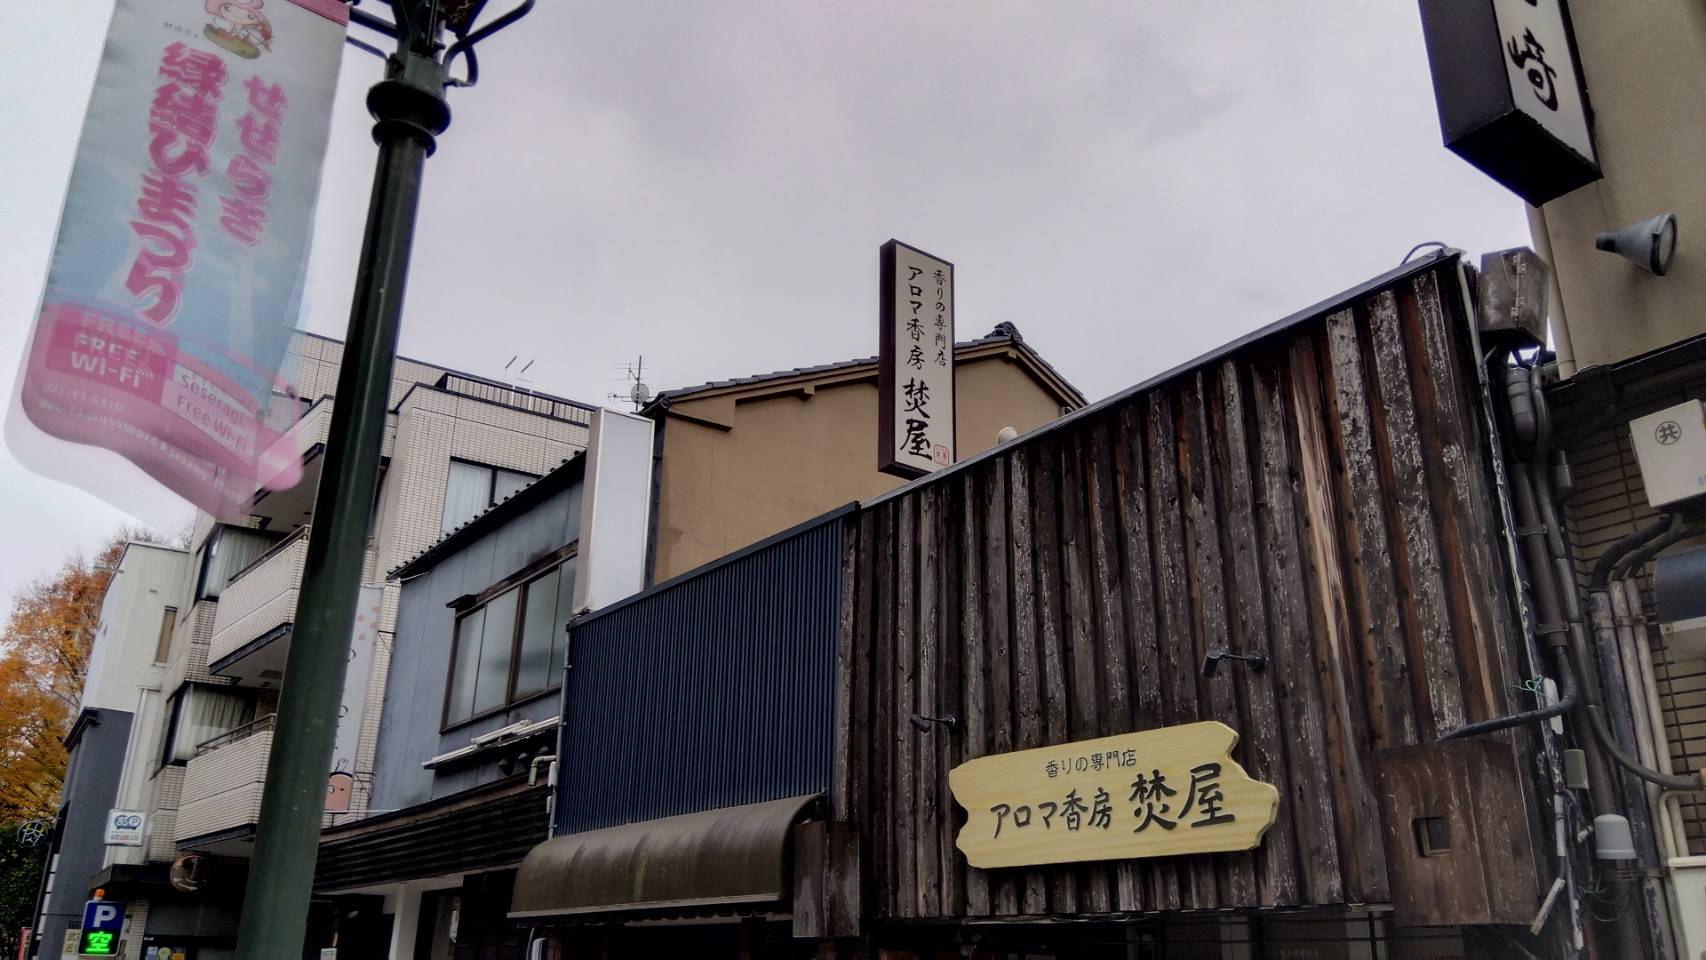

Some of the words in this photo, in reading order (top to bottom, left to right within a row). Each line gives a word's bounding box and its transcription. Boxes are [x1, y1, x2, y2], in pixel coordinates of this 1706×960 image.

[218, 74, 288, 247] せせらぎ
[933, 269, 947, 367] 香りの専門店
[71, 351, 141, 388] Wi-Fi
[176, 394, 212, 426] Free
[180, 374, 245, 425] Seseragi
[1045, 748, 1137, 778] 香りの専門店
[93, 905, 117, 927] P
[85, 931, 113, 952] 空
